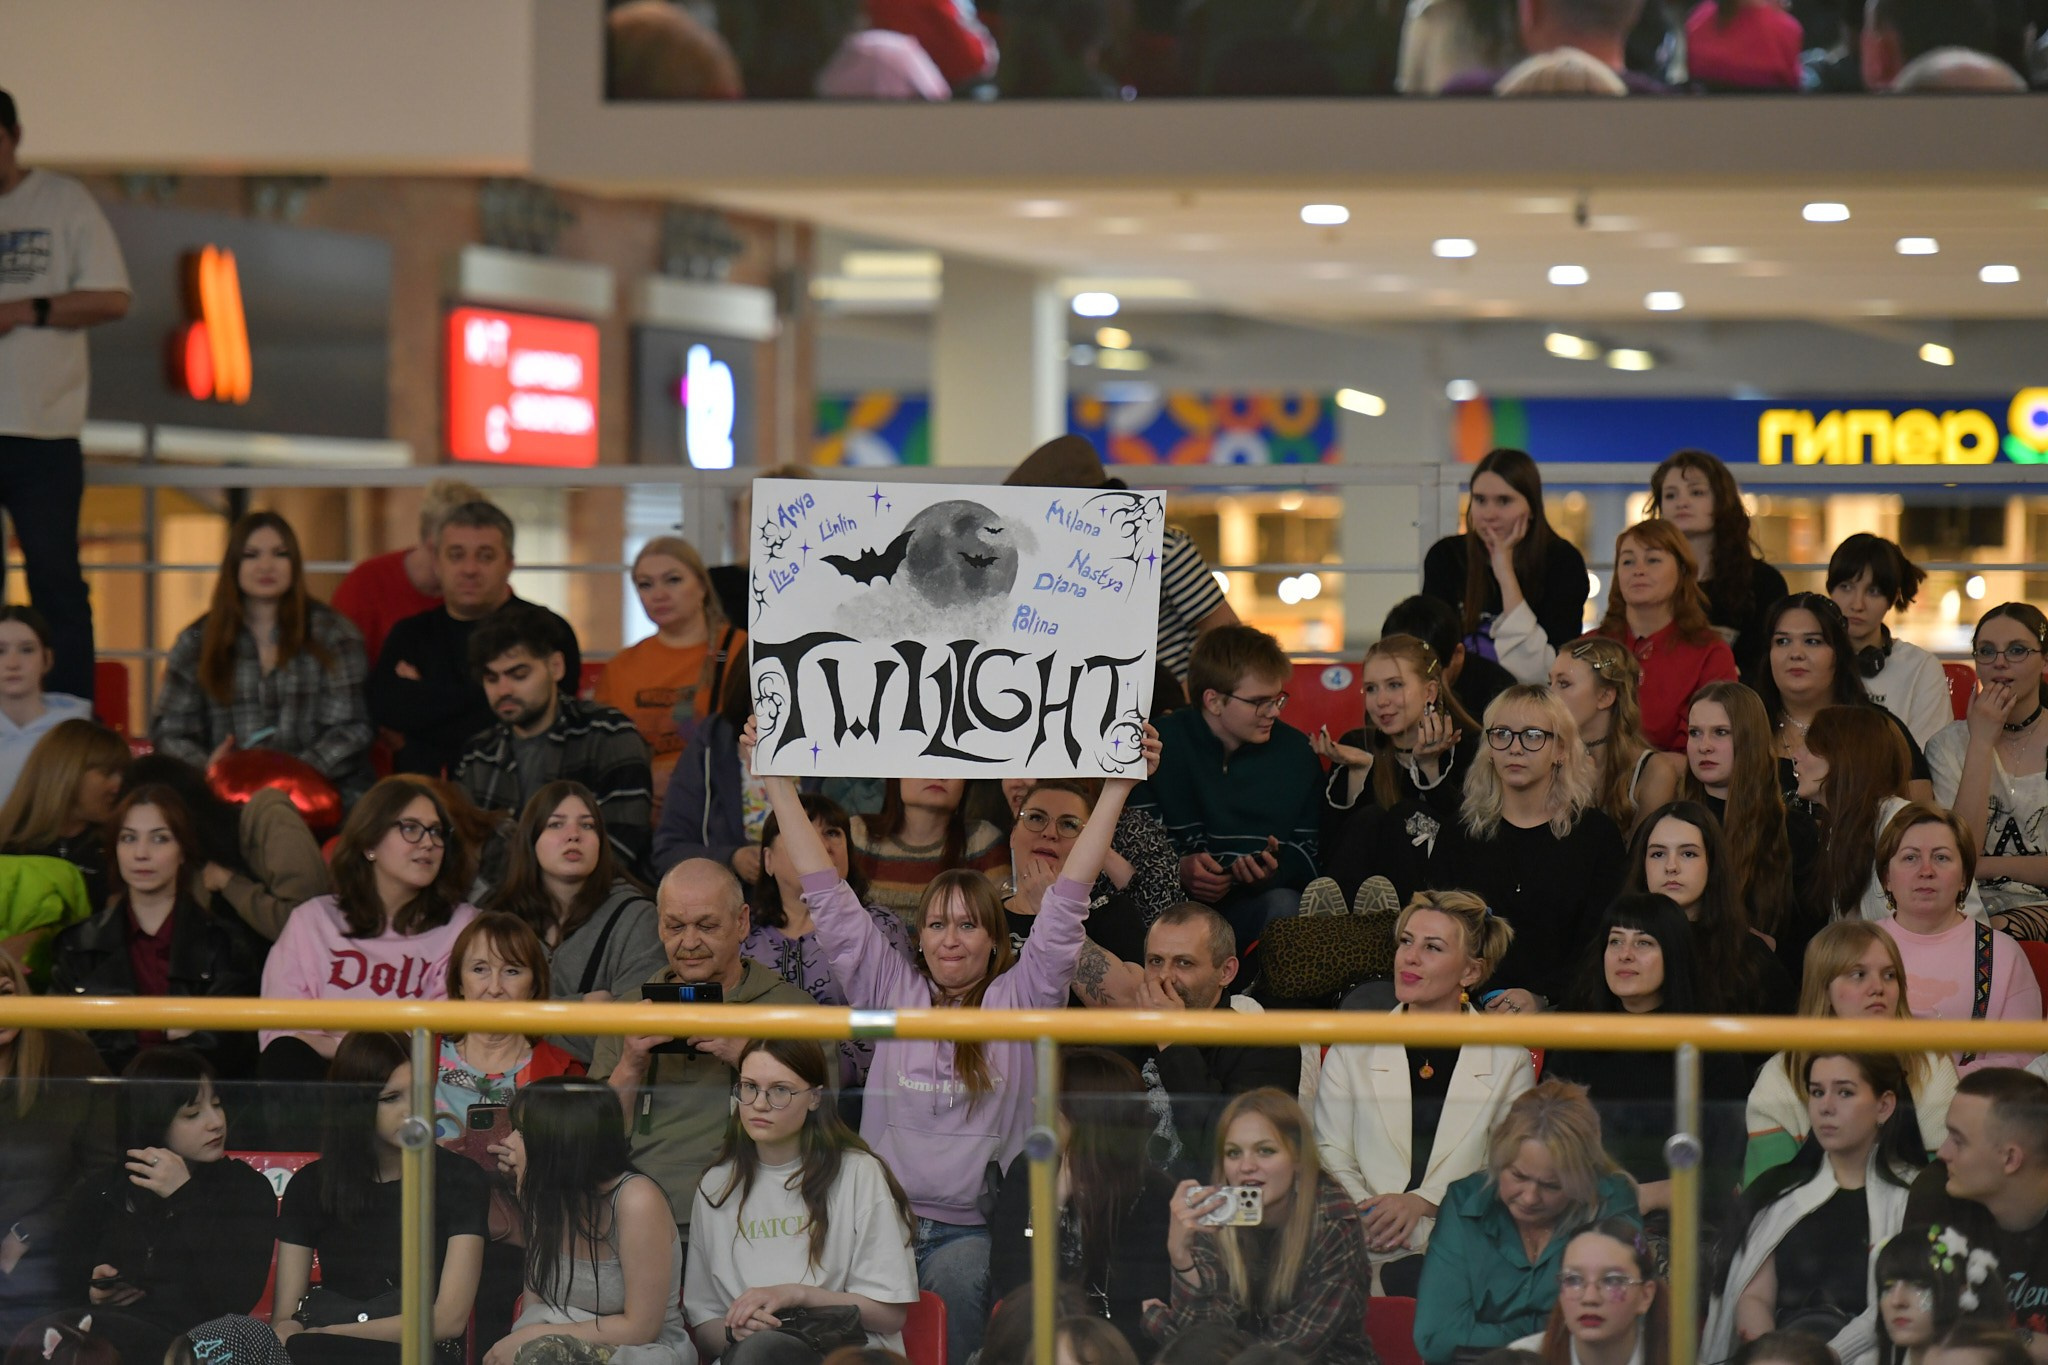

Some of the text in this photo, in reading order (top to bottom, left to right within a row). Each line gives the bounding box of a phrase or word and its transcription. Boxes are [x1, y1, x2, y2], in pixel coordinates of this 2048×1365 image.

[776, 491, 816, 530] Anya
[1045, 499, 1101, 538] Milana
[768, 560, 801, 595] Liza
[1032, 572, 1088, 599] Diana
[1067, 549, 1124, 594] Nastya
[1012, 603, 1060, 636] Polina
[1331, 670, 1342, 686] 4
[752, 631, 1147, 770] TWILIGHT
[273, 1173, 283, 1193] 1
